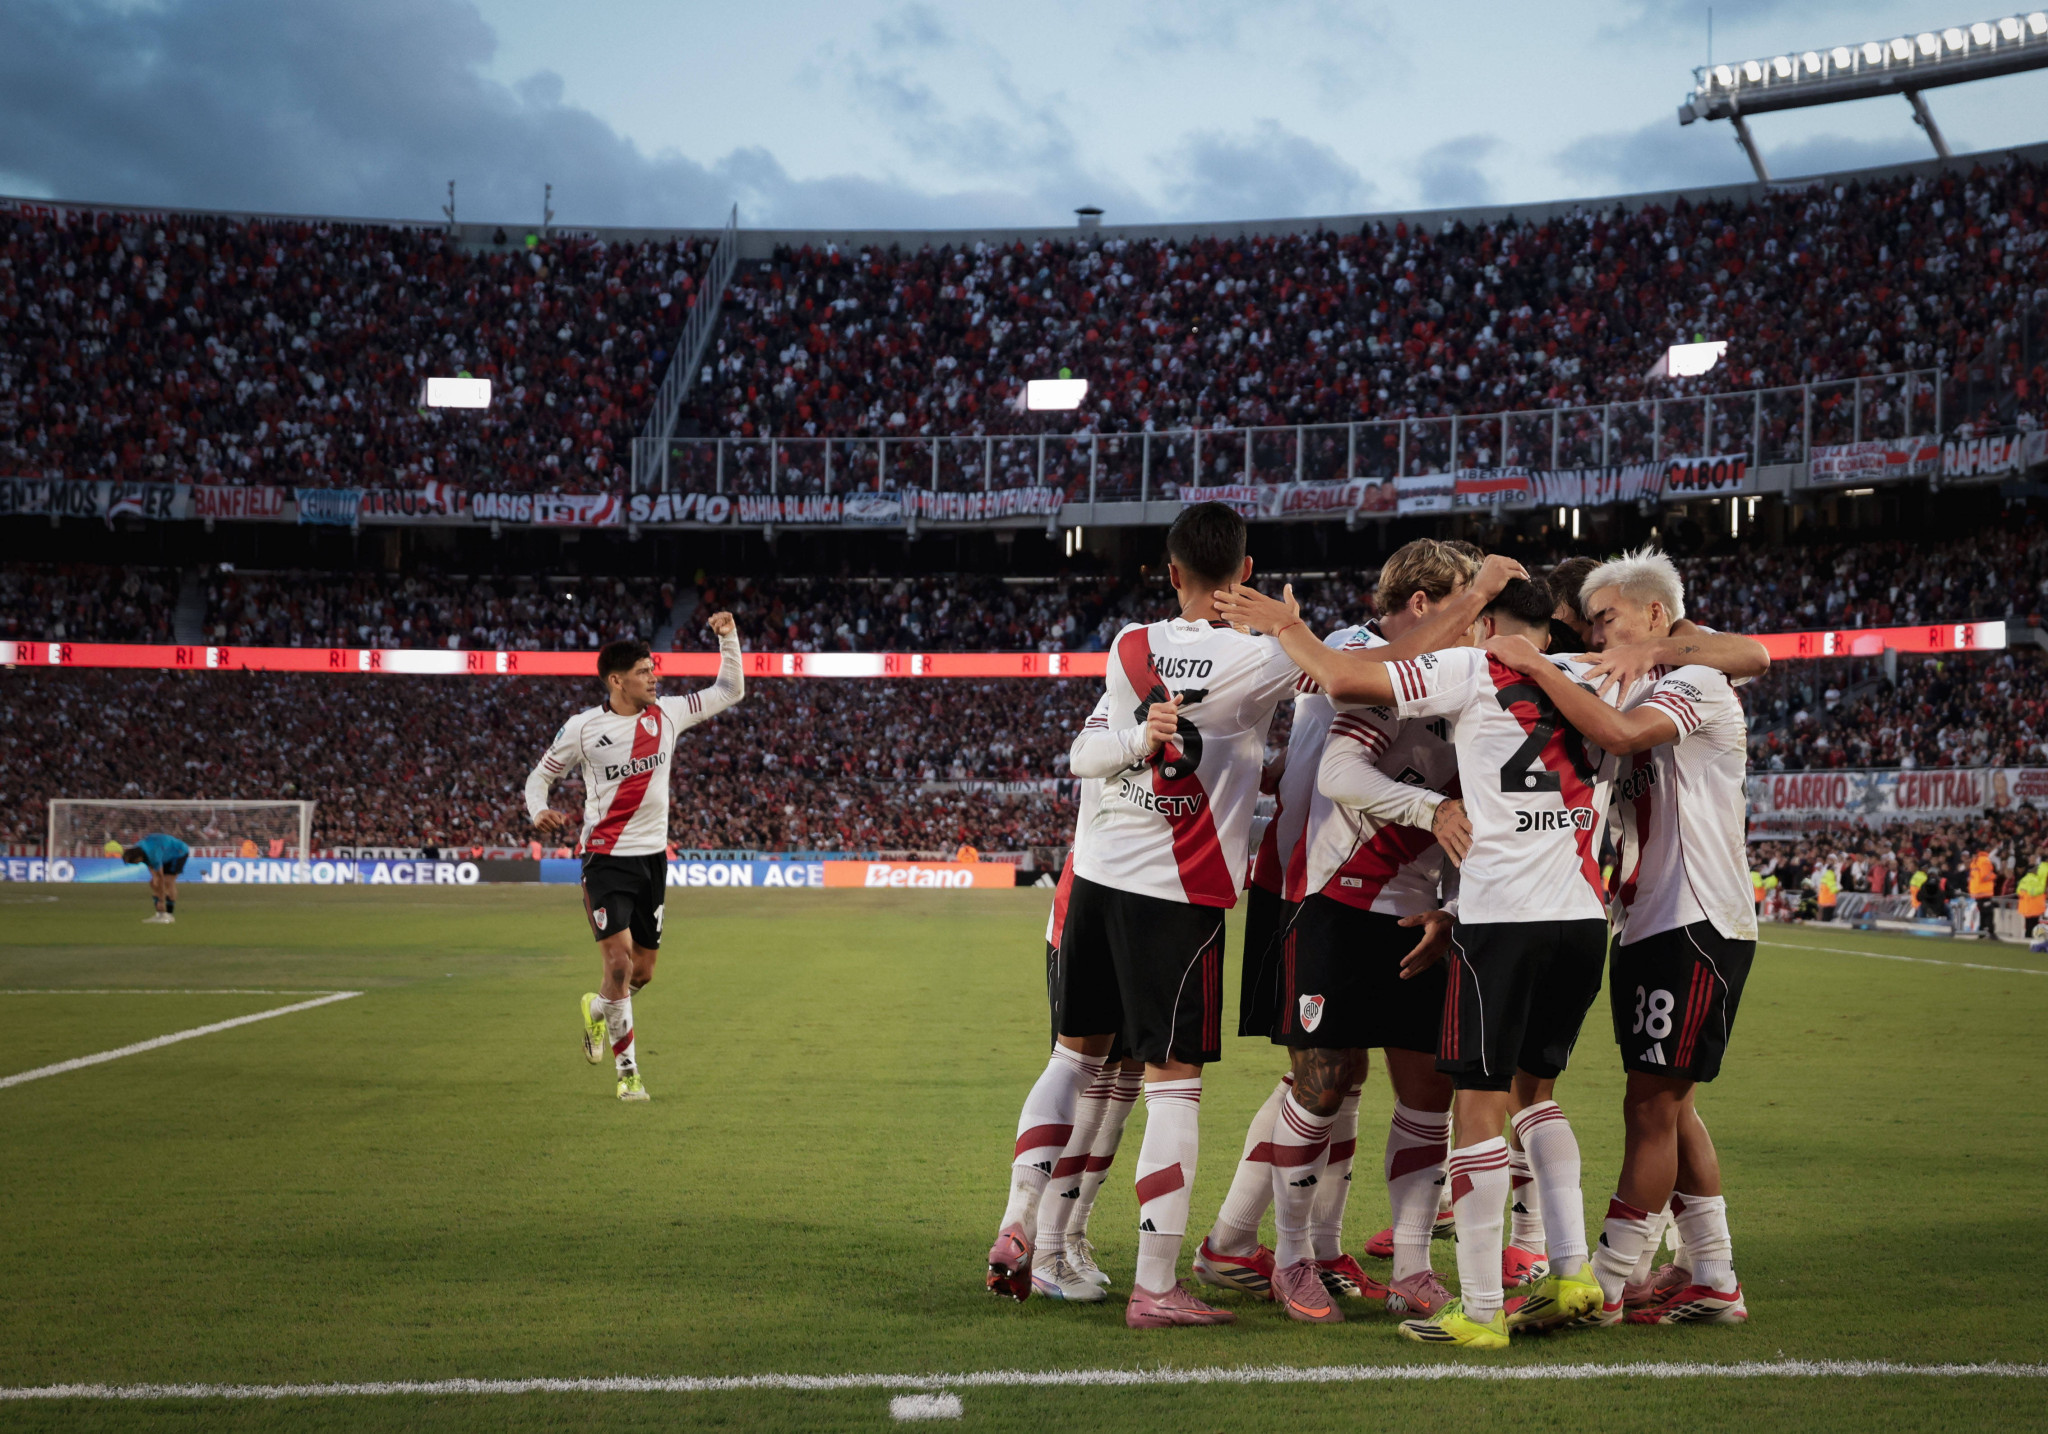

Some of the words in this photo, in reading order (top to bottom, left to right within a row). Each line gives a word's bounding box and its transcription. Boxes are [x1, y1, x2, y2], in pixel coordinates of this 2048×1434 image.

[1943, 434, 2021, 477] RAFAELA
[1668, 458, 1746, 491] CABOT
[109, 485, 175, 517] RER
[195, 488, 286, 517] BANFIELD
[472, 491, 532, 521] OASIS
[628, 493, 730, 523] SAVIO
[738, 494, 783, 523] BAHIA
[784, 494, 840, 523] BLANCA
[1477, 490, 1527, 506] CEIBO
[1147, 653, 1213, 679] FAUSTO
[1662, 679, 1703, 697] ASSIST
[604, 752, 666, 780] Betano
[1119, 777, 1203, 816] DIRECTV
[1774, 774, 1848, 811] BARRIO
[1895, 770, 1981, 808] CENTRAL
[202, 861, 358, 885] JOHNSON
[371, 861, 480, 886] ACERO
[864, 864, 975, 888] Betano
[1632, 984, 1675, 1040] 38
